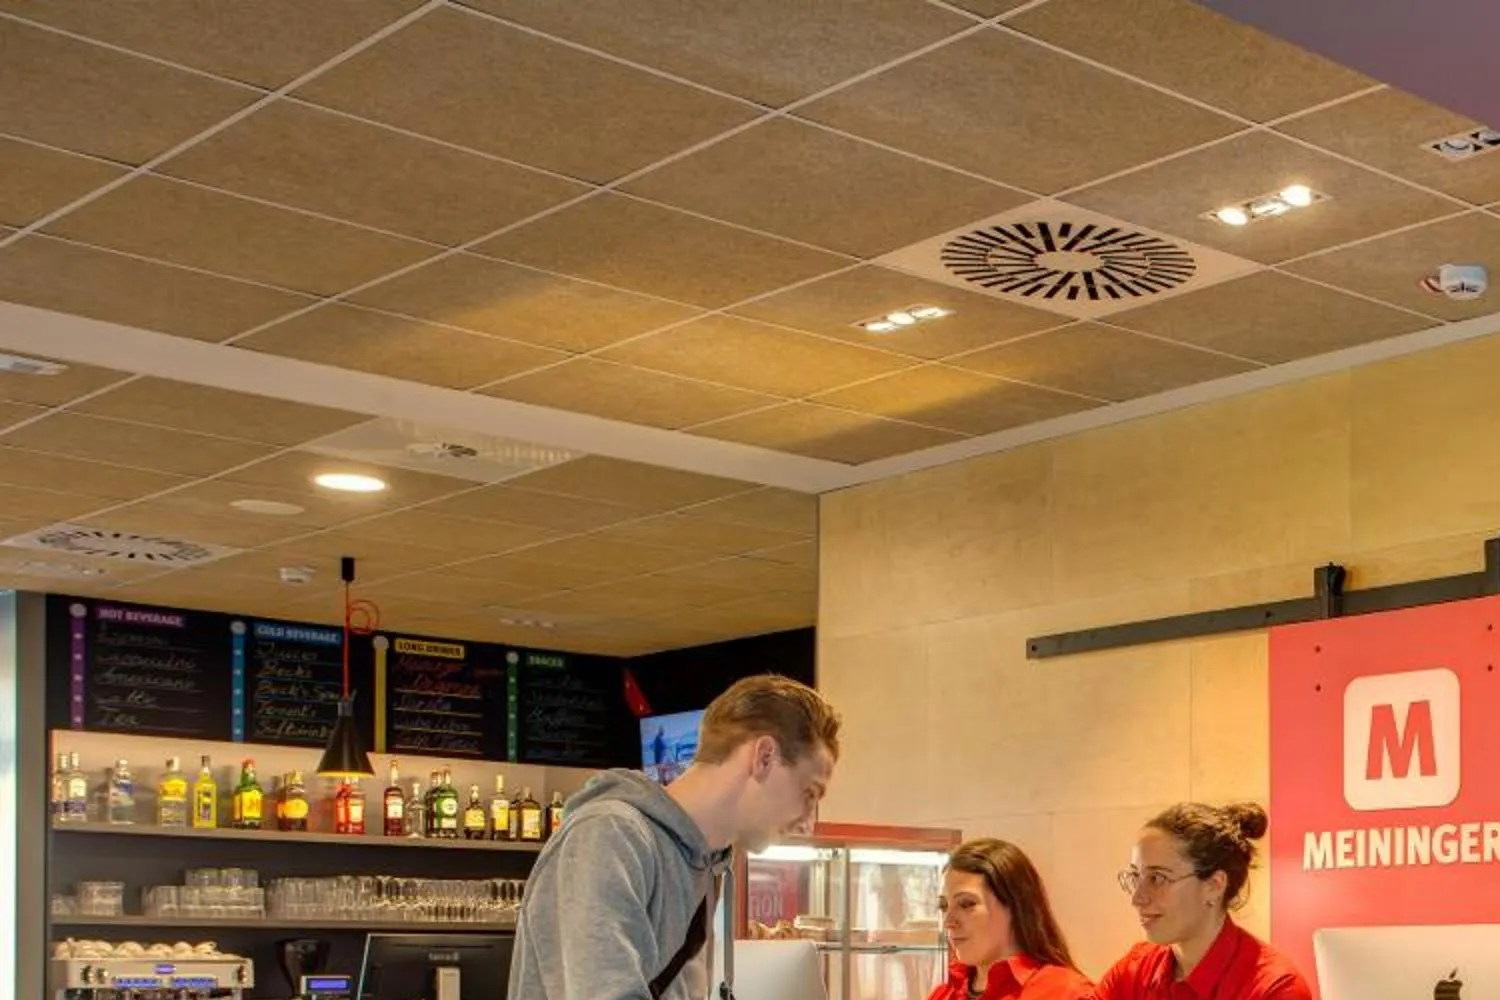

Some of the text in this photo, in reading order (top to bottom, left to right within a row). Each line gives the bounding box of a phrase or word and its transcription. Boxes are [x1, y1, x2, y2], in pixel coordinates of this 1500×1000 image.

[98, 608, 185, 626] HOT BEVERAGE
[257, 626, 338, 643] COLD BEVERAGE
[399, 640, 424, 653] LONG
[1364, 699, 1438, 781] M
